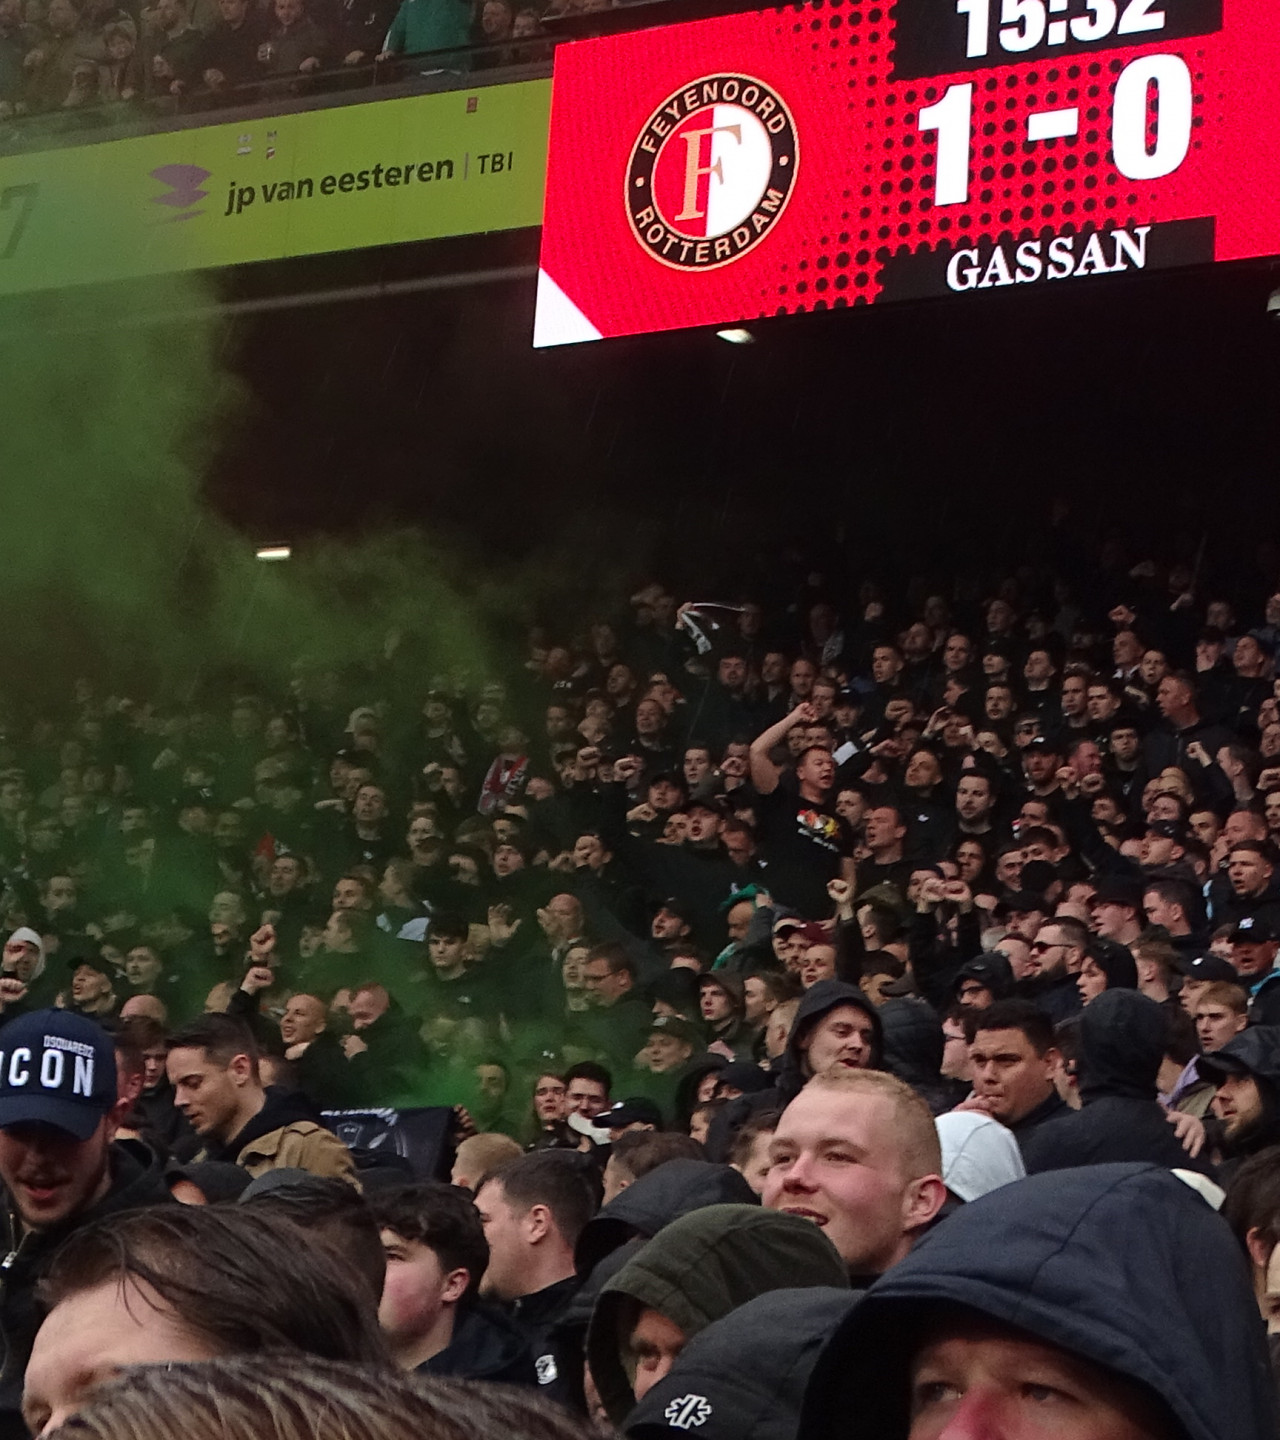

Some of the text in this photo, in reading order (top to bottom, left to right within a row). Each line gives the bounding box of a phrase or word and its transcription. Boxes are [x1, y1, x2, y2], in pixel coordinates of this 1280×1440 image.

[640, 79, 786, 154] FEYENOORD
[918, 82, 972, 206] 1
[1112, 53, 1192, 180] 0
[224, 151, 514, 216] jp van eesteren TBI
[674, 123, 742, 222] F
[634, 187, 785, 264] ROTTERDAM
[946, 226, 1151, 291] GASSAN
